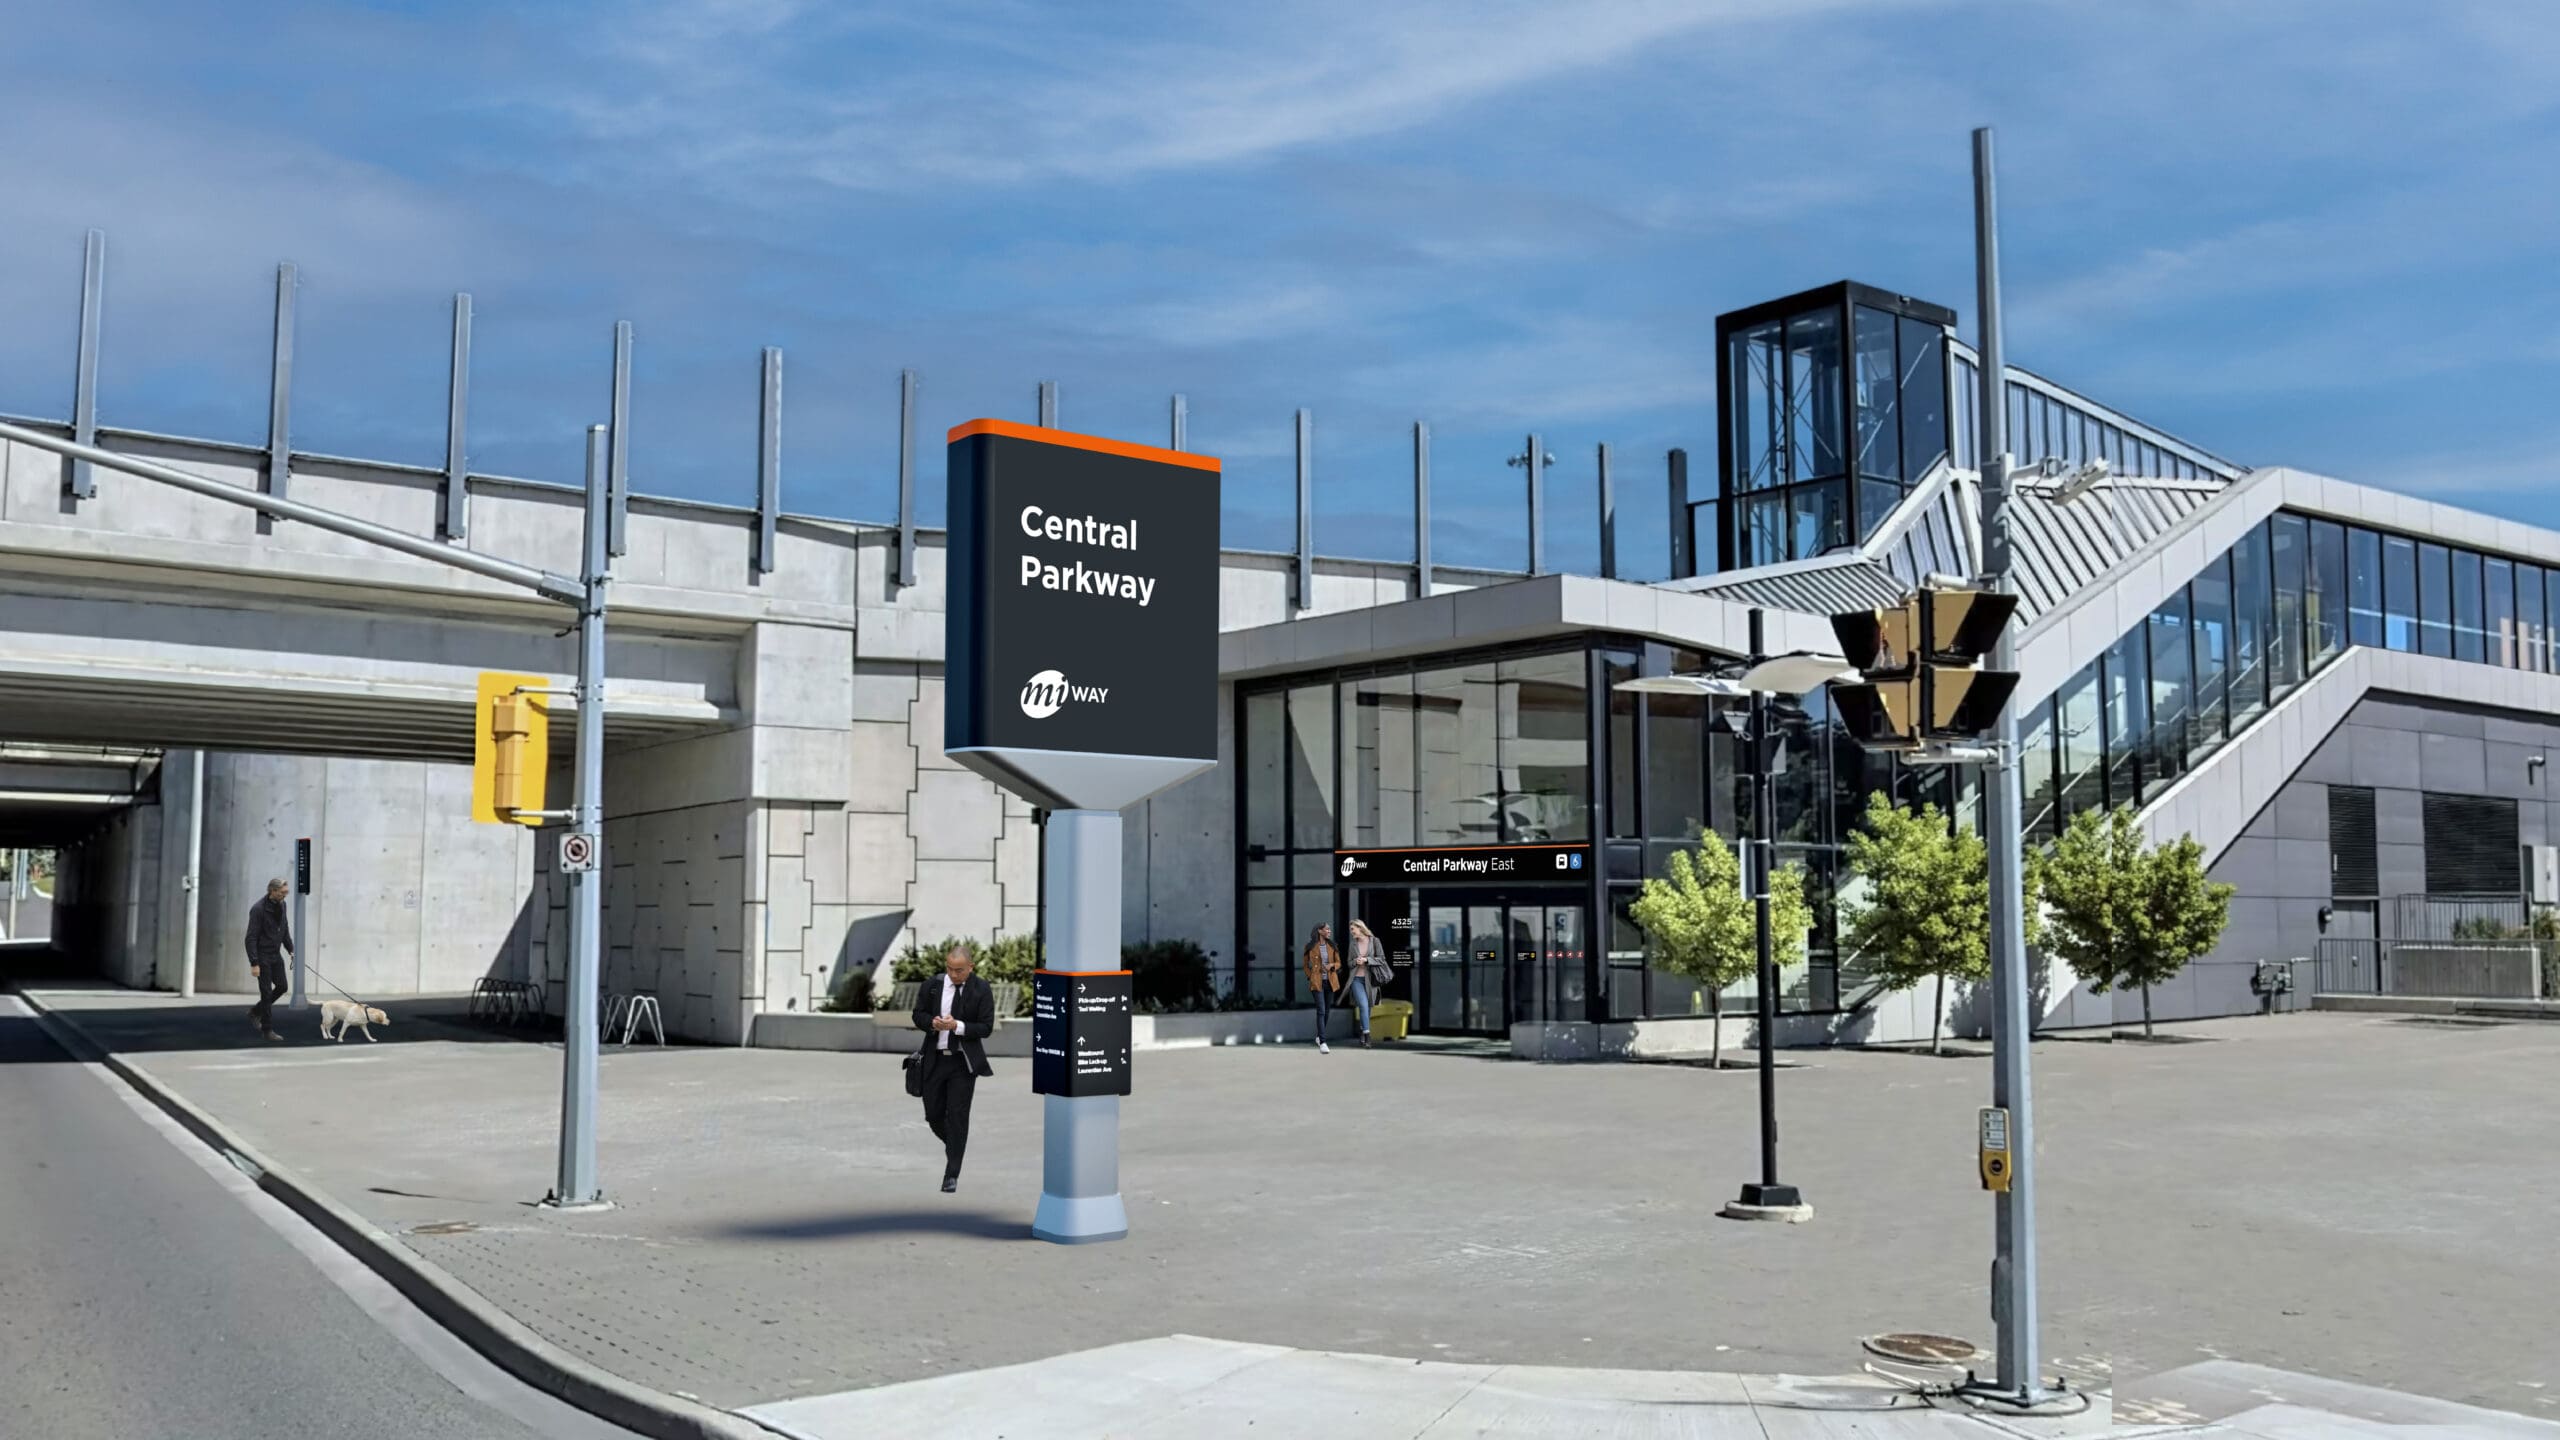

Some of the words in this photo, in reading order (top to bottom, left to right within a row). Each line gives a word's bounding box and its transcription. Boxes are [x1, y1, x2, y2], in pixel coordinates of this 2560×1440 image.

[1021, 505, 1137, 550] Central
[1021, 555, 1155, 606] Parkway
[1403, 858, 1440, 872] Central
[1443, 858, 1488, 873] Parkway
[1491, 858, 1515, 871] East
[1391, 918, 1412, 926] 4325
